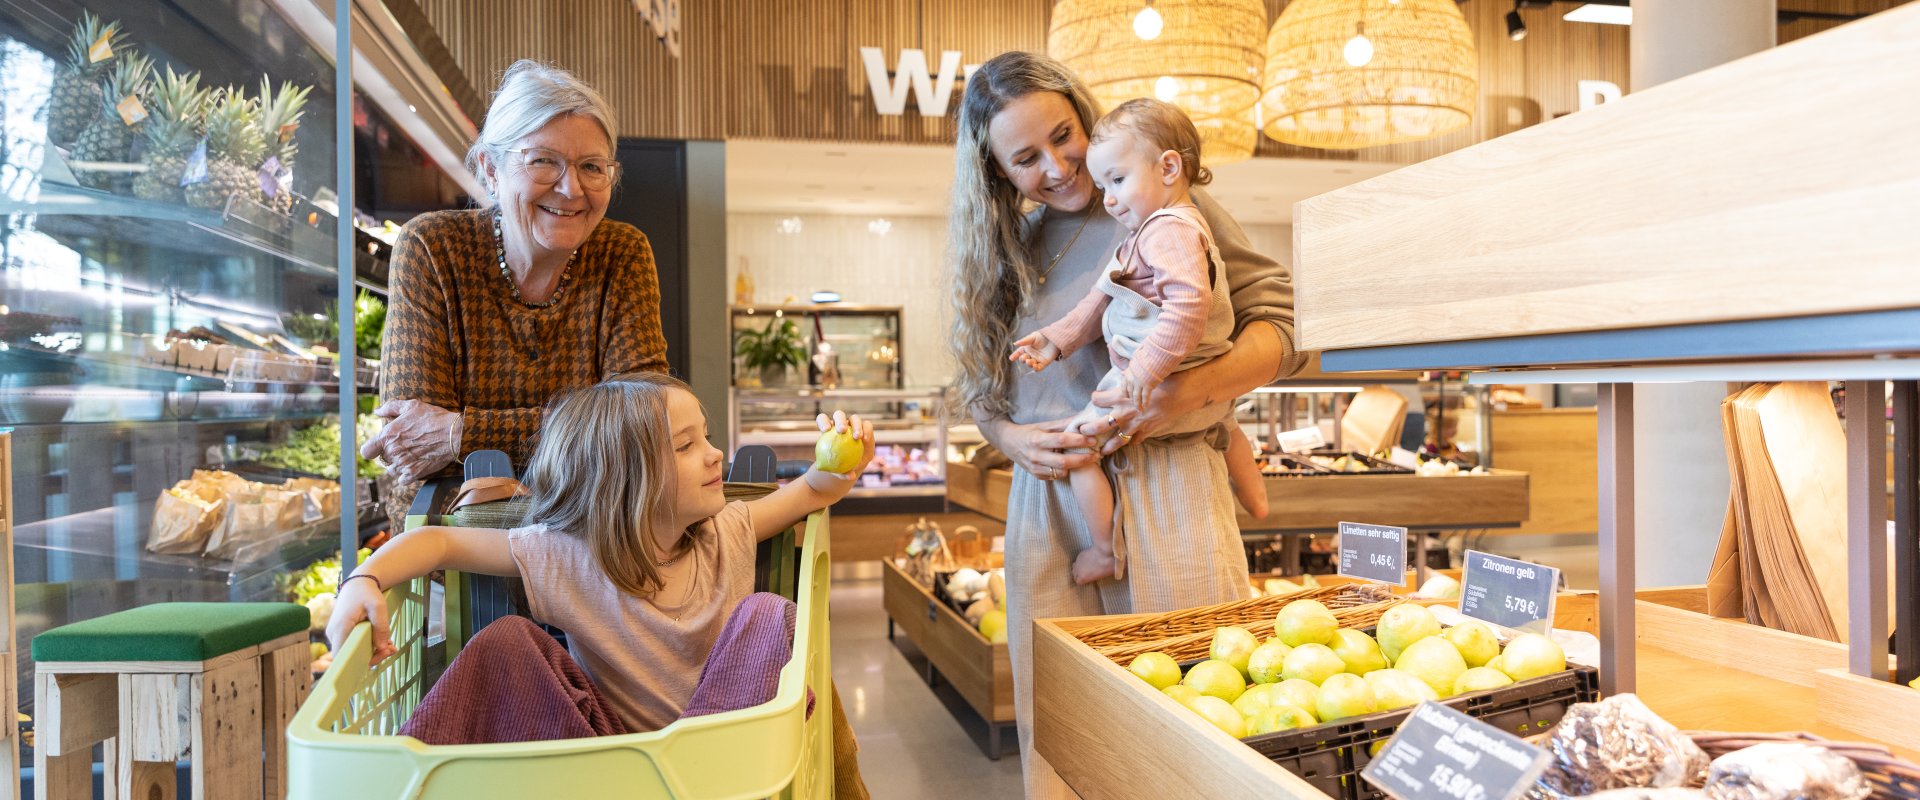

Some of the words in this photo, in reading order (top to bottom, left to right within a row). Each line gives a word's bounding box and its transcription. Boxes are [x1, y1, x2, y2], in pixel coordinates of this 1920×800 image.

[1342, 525, 1367, 537] Limetten
[1368, 528, 1381, 538] sehr
[1382, 529, 1400, 543] saftig
[1482, 558, 1515, 575] Zitronen
[1516, 567, 1536, 580] gelb
